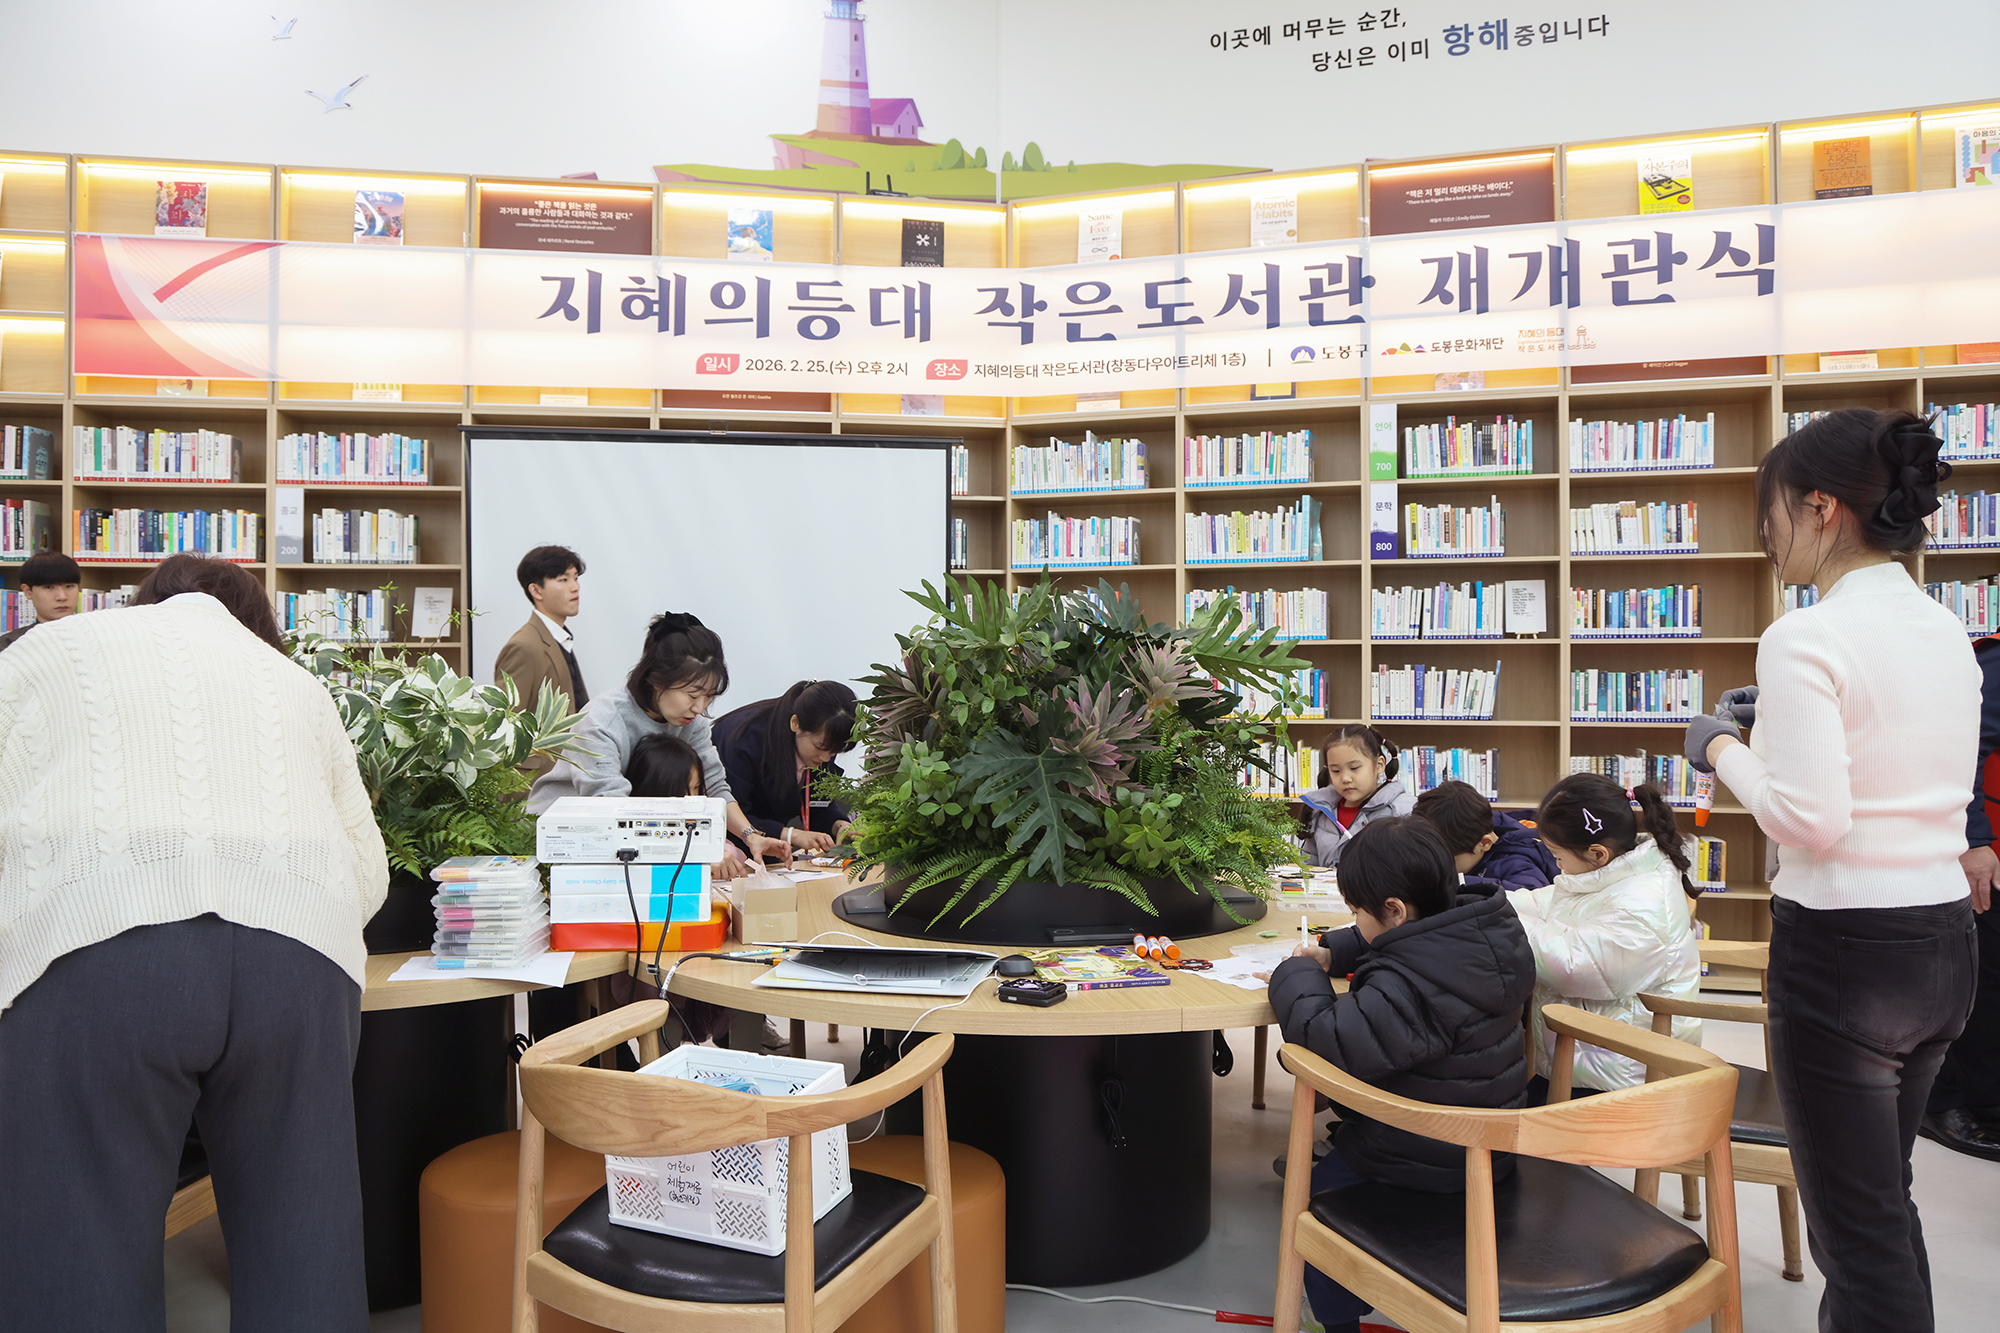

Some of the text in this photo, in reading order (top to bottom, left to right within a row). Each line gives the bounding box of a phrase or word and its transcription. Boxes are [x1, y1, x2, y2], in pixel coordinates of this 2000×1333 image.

[1209, 8, 1407, 51] 이곳에 머무는 순간,
[1311, 46, 1376, 72] 당신은
[1387, 38, 1430, 63] 이미
[1823, 140, 1861, 155] 도둑맞은
[1641, 159, 1689, 172] 자본주의
[1828, 153, 1857, 167] 집중력
[1822, 170, 1864, 180] STOLEN
[1825, 177, 1863, 187] FOCUS
[1425, 188, 1432, 196] 저
[1434, 187, 1448, 196] 멀리
[1450, 184, 1485, 195] 데려다주는
[552, 202, 567, 210] 책을
[568, 202, 582, 210] 읽는
[583, 203, 597, 211] 것은
[1254, 199, 1296, 211] Atomic
[499, 207, 520, 215] 과거의
[521, 208, 542, 216] 훌륭한
[543, 208, 570, 218] 사람들과
[571, 209, 599, 219] 대화하는
[600, 211, 613, 219] 것과
[1256, 209, 1294, 220] Habits
[1090, 225, 1111, 234] Ever
[536, 223, 1776, 344] 지혜의등대 작은도서관 재개관식
[1430, 337, 1505, 353] 도봉문화재단
[1321, 343, 1368, 360] 도봉구
[703, 357, 908, 376] 일시 2026. 2. 25.(수) 오후 2시
[934, 362, 961, 377] 장소
[973, 364, 1039, 379] 지혜의등대
[1220, 352, 1247, 367] 1층)
[1374, 421, 1392, 432] 언어
[1375, 462, 1392, 471] 700
[1375, 502, 1392, 512] 문학
[280, 546, 298, 555] 200
[1375, 542, 1392, 551] 800
[667, 1160, 695, 1173] 어린이
